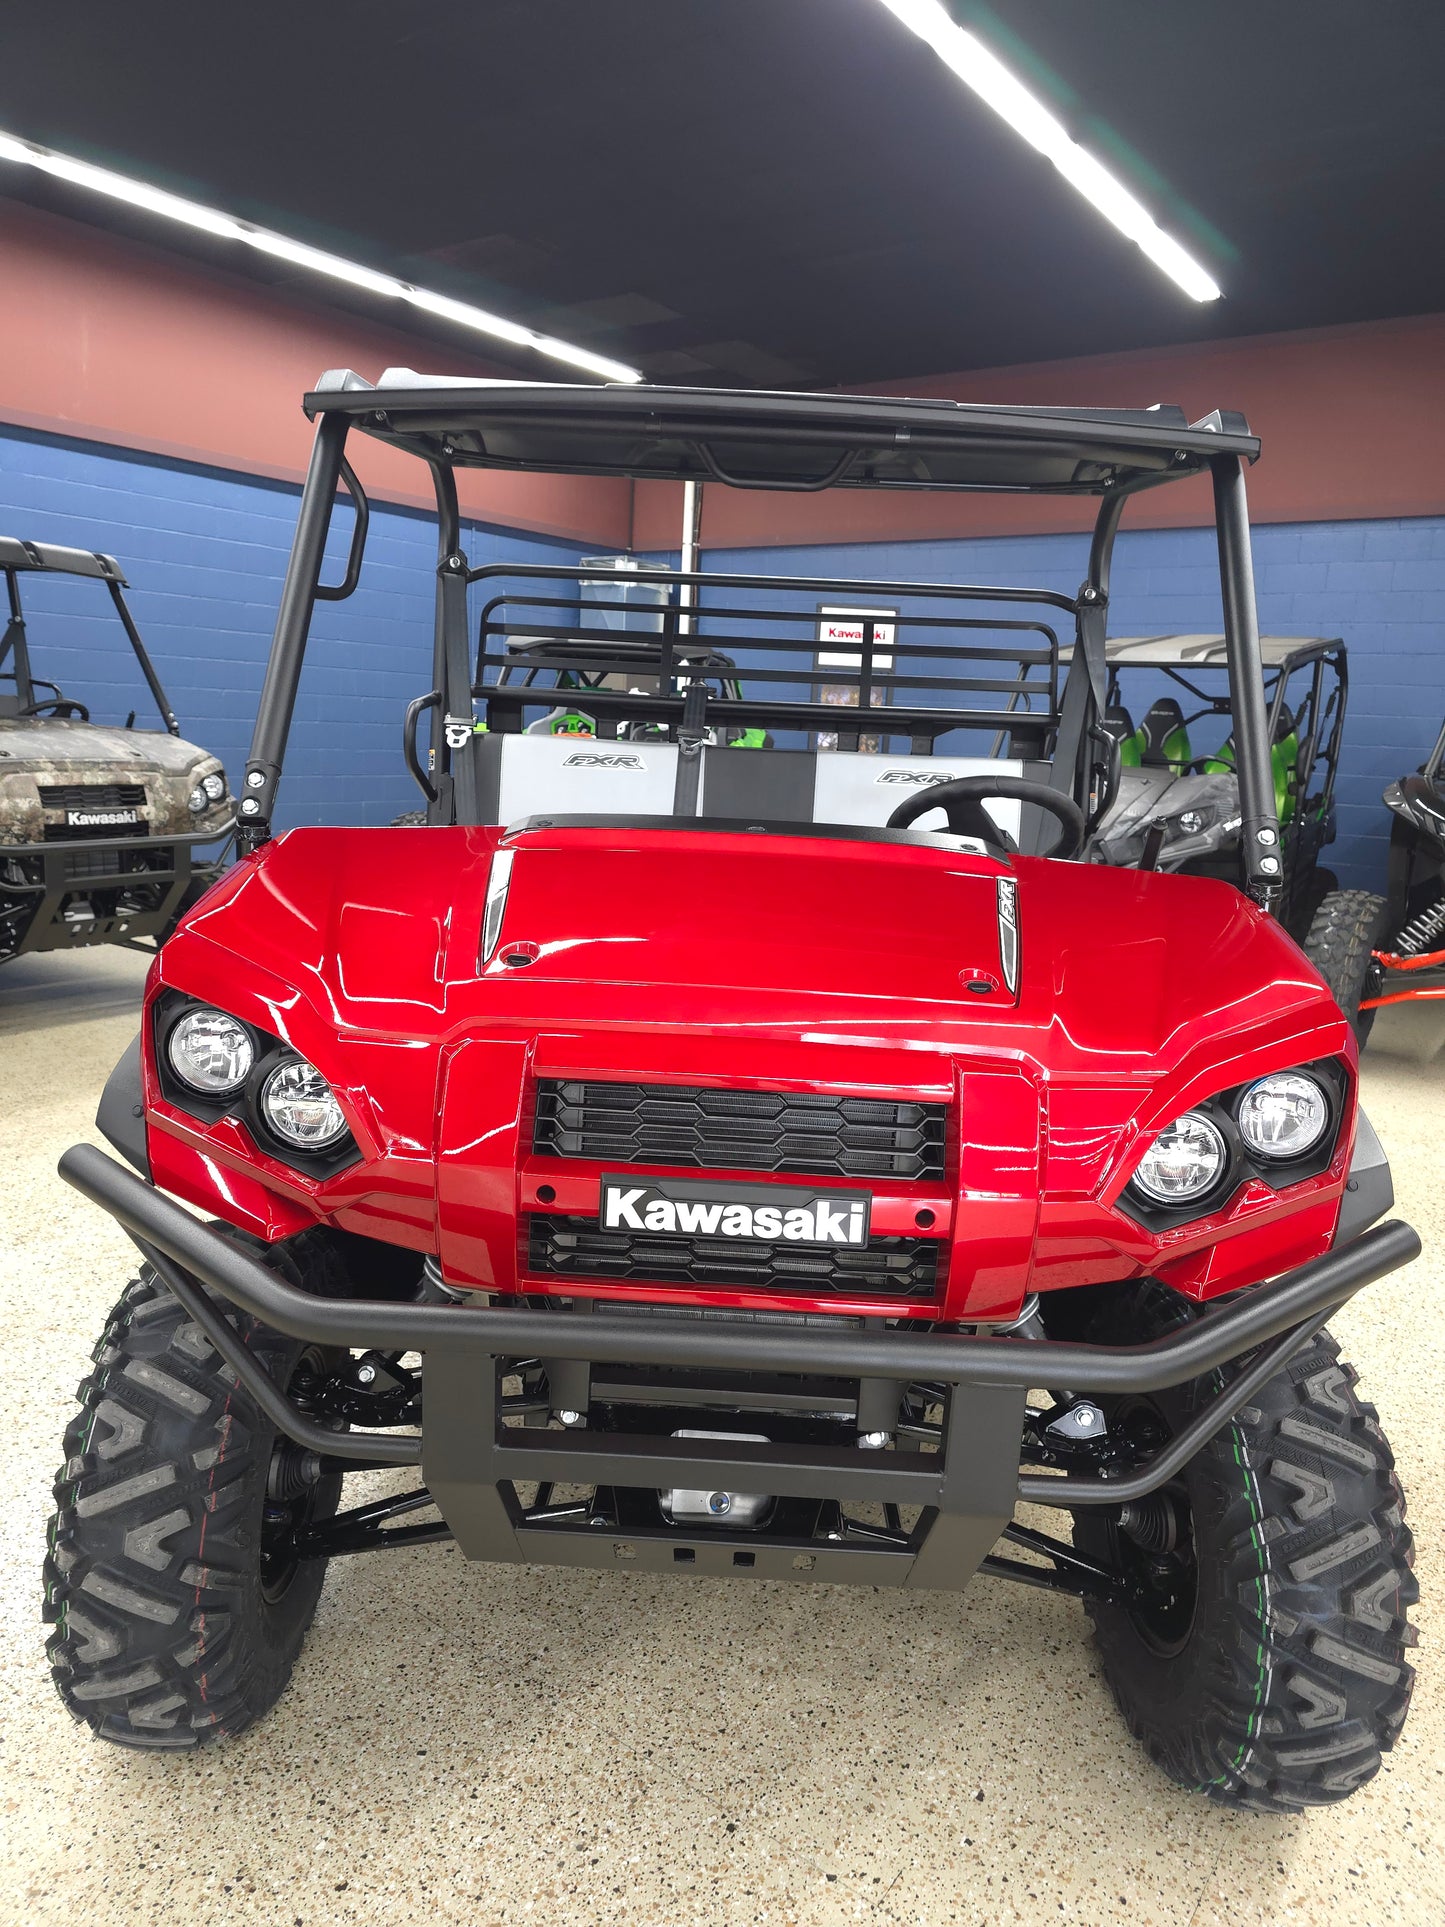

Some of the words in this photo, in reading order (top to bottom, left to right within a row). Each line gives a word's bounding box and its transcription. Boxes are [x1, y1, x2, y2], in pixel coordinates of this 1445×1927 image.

[828, 627, 887, 640] Kawaki
[564, 753, 642, 769] FXR
[68, 810, 138, 826] Kawasaki
[605, 1187, 864, 1244] Kawasaki
